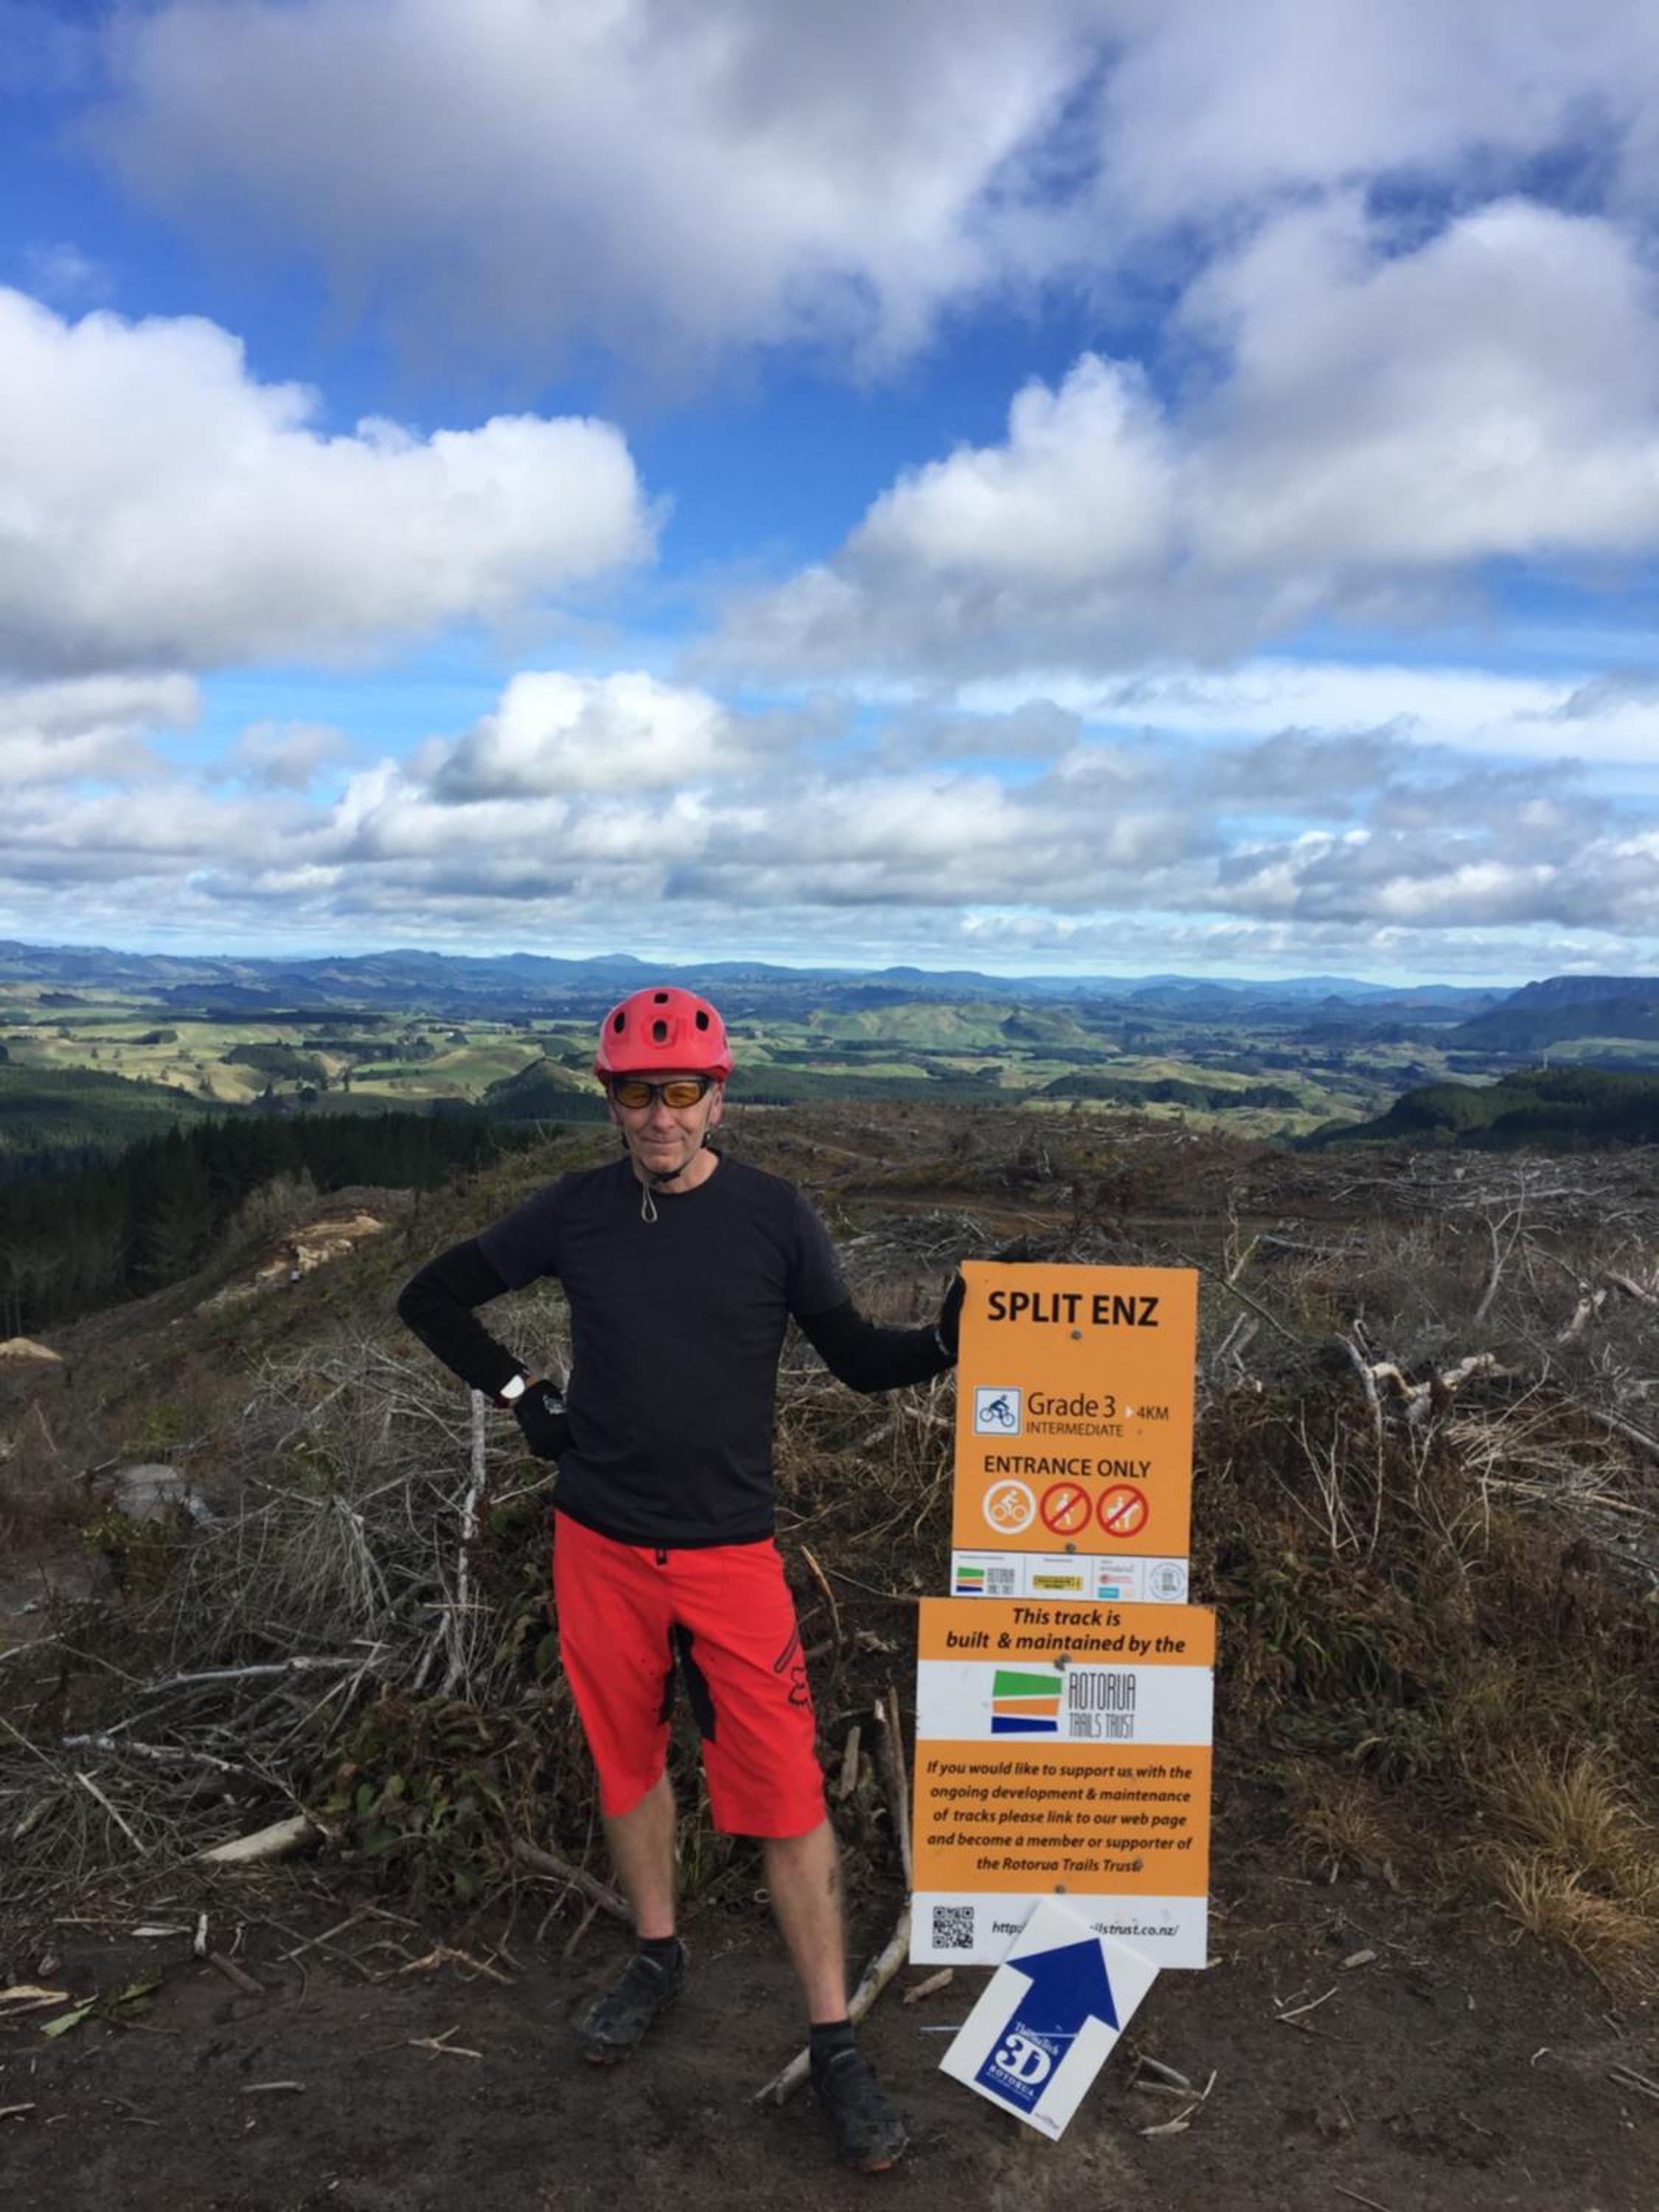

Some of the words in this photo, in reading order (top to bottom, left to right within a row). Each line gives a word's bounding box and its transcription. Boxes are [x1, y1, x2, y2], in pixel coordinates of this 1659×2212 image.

[987, 1290, 1082, 1324] SPLIT
[1091, 1295, 1160, 1327] ENZ
[1027, 1392, 1099, 1417] Grade
[1103, 1395, 1116, 1419] 3
[1136, 1406, 1169, 1422] 4KM
[1026, 1421, 1124, 1437] INTERMEDIATE
[984, 1455, 1091, 1476] ENTRANCE
[1096, 1459, 1152, 1478] ONLY
[1012, 1608, 1050, 1625] This
[1054, 1610, 1102, 1627] track
[1106, 1613, 1121, 1627] is
[946, 1632, 989, 1649] built
[998, 1634, 1011, 1649] &
[1016, 1635, 1124, 1652] maintained
[1129, 1637, 1151, 1655] by
[1155, 1638, 1186, 1653] the
[1068, 1672, 1136, 1711] ROTORUA
[927, 1760, 938, 1773] If
[939, 1765, 965, 1777] you
[969, 1761, 1012, 1775] would
[1015, 1762, 1039, 1775] like
[1042, 1764, 1057, 1775] to
[1059, 1765, 1115, 1779] support
[1116, 1768, 1133, 1778] us
[1136, 1765, 1166, 1778] with
[1169, 1766, 1192, 1779] the
[930, 1785, 989, 1801] ongoing
[992, 1786, 1083, 1801] development
[1085, 1788, 1096, 1800] &
[1099, 1789, 1192, 1802] maintenance
[933, 1808, 949, 1821] of
[953, 1809, 995, 1822] tracks
[998, 1810, 1044, 1825] please
[1046, 1811, 1073, 1823] link
[1076, 1813, 1091, 1824] to
[1093, 1815, 1117, 1825] our
[1121, 1813, 1150, 1825] web
[1151, 1816, 1187, 1829] page
[927, 1832, 955, 1845] and
[958, 1832, 1012, 1846] become
[1015, 1835, 1024, 1846] a
[1026, 1834, 1085, 1848] member
[1088, 1837, 1103, 1848] or
[1105, 1837, 1175, 1851] supporter
[1177, 1837, 1192, 1850] of
[976, 1857, 1000, 1871] the
[1002, 1857, 1059, 1871] Rotorua
[1063, 1858, 1099, 1872] Trails
[995, 2033, 1051, 2085] 3D
